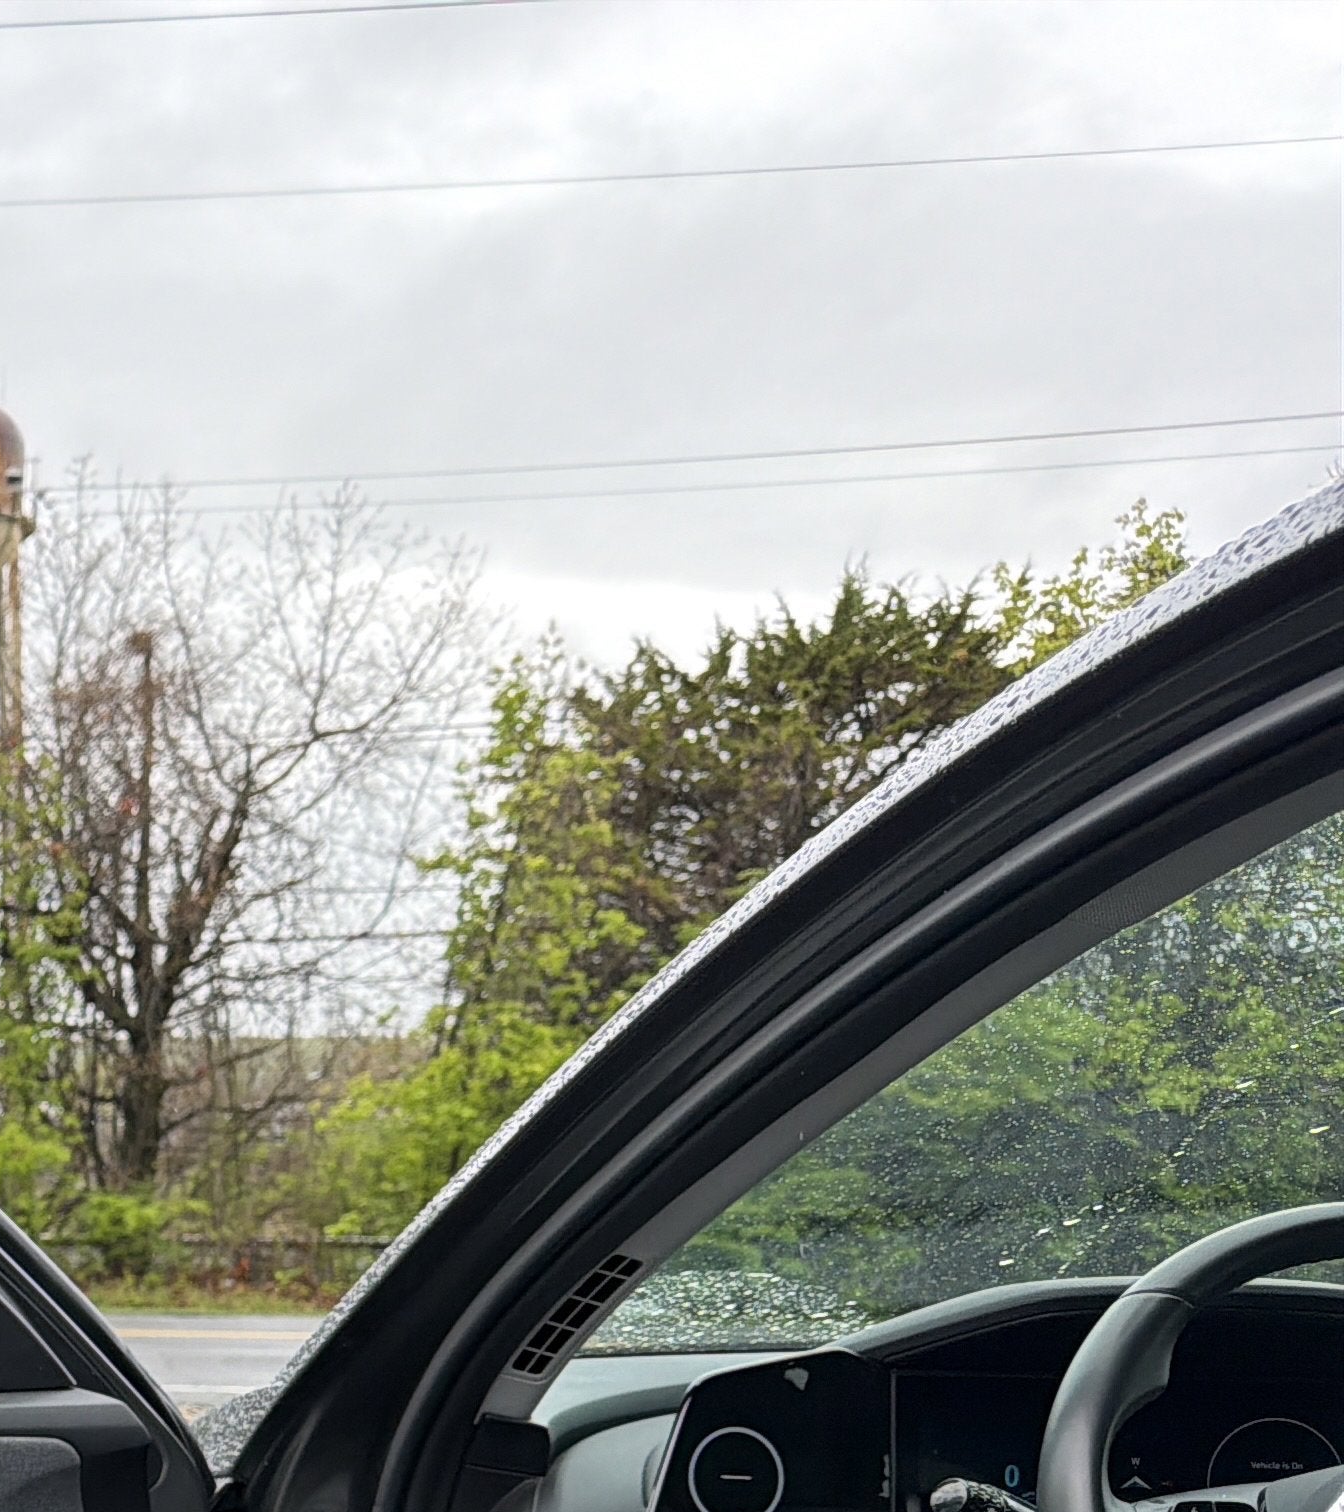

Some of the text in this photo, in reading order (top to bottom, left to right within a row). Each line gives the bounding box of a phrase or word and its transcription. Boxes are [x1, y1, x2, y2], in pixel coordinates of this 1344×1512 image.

[1131, 1457, 1141, 1466] W
[1250, 1461, 1304, 1470] Vehicle is On
[1004, 1464, 1020, 1488] 0
